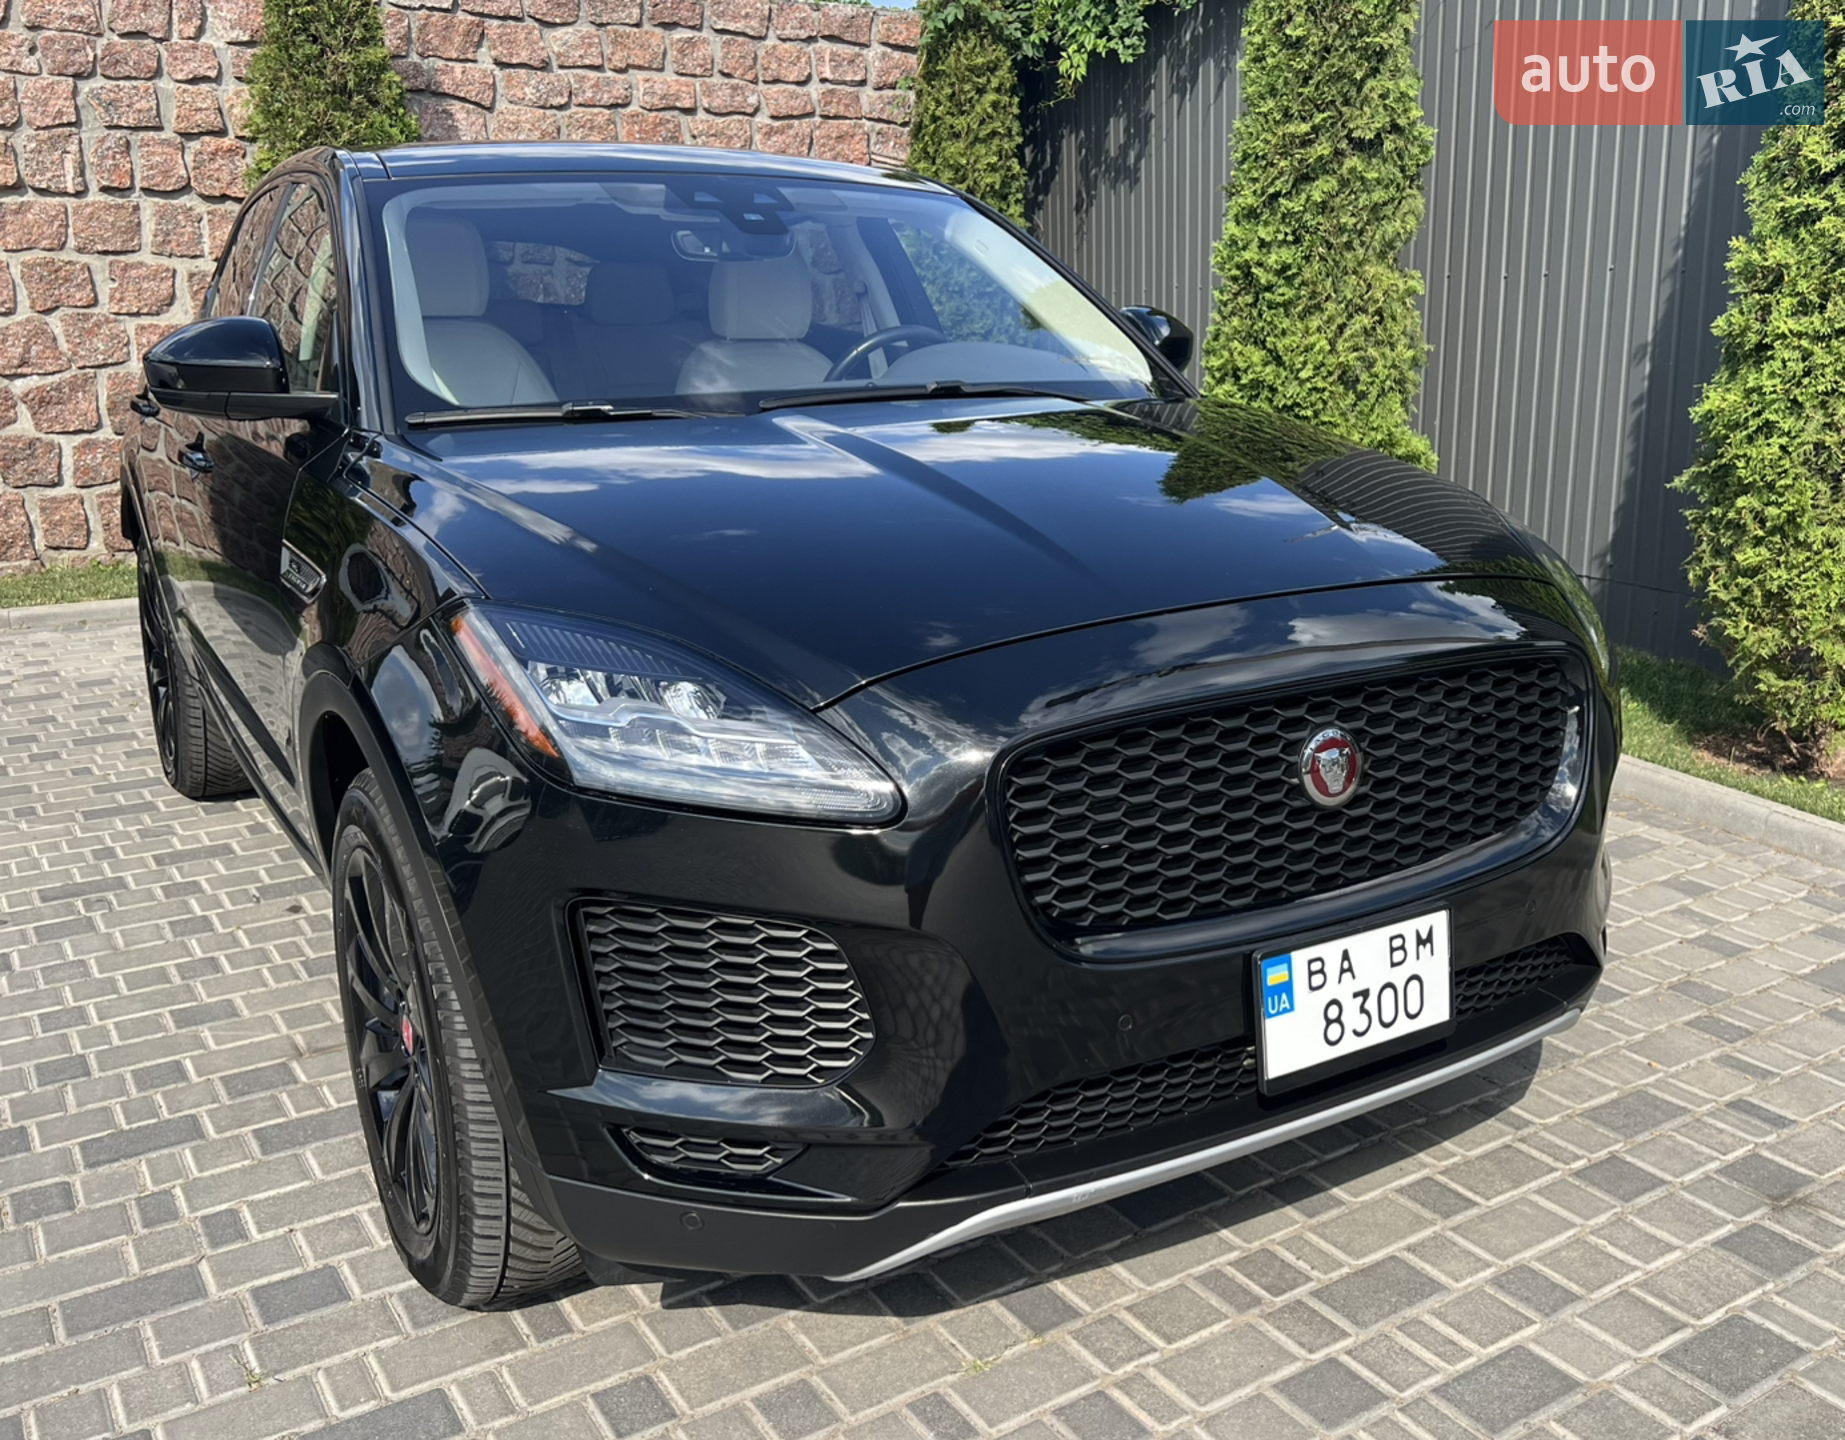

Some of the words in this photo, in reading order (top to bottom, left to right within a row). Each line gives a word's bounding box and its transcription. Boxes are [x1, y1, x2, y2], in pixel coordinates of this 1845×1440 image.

[1307, 948, 1356, 992] BA
[1389, 924, 1434, 968] BM
[1267, 992, 1290, 1014] UA
[1323, 973, 1424, 1047] 8300
